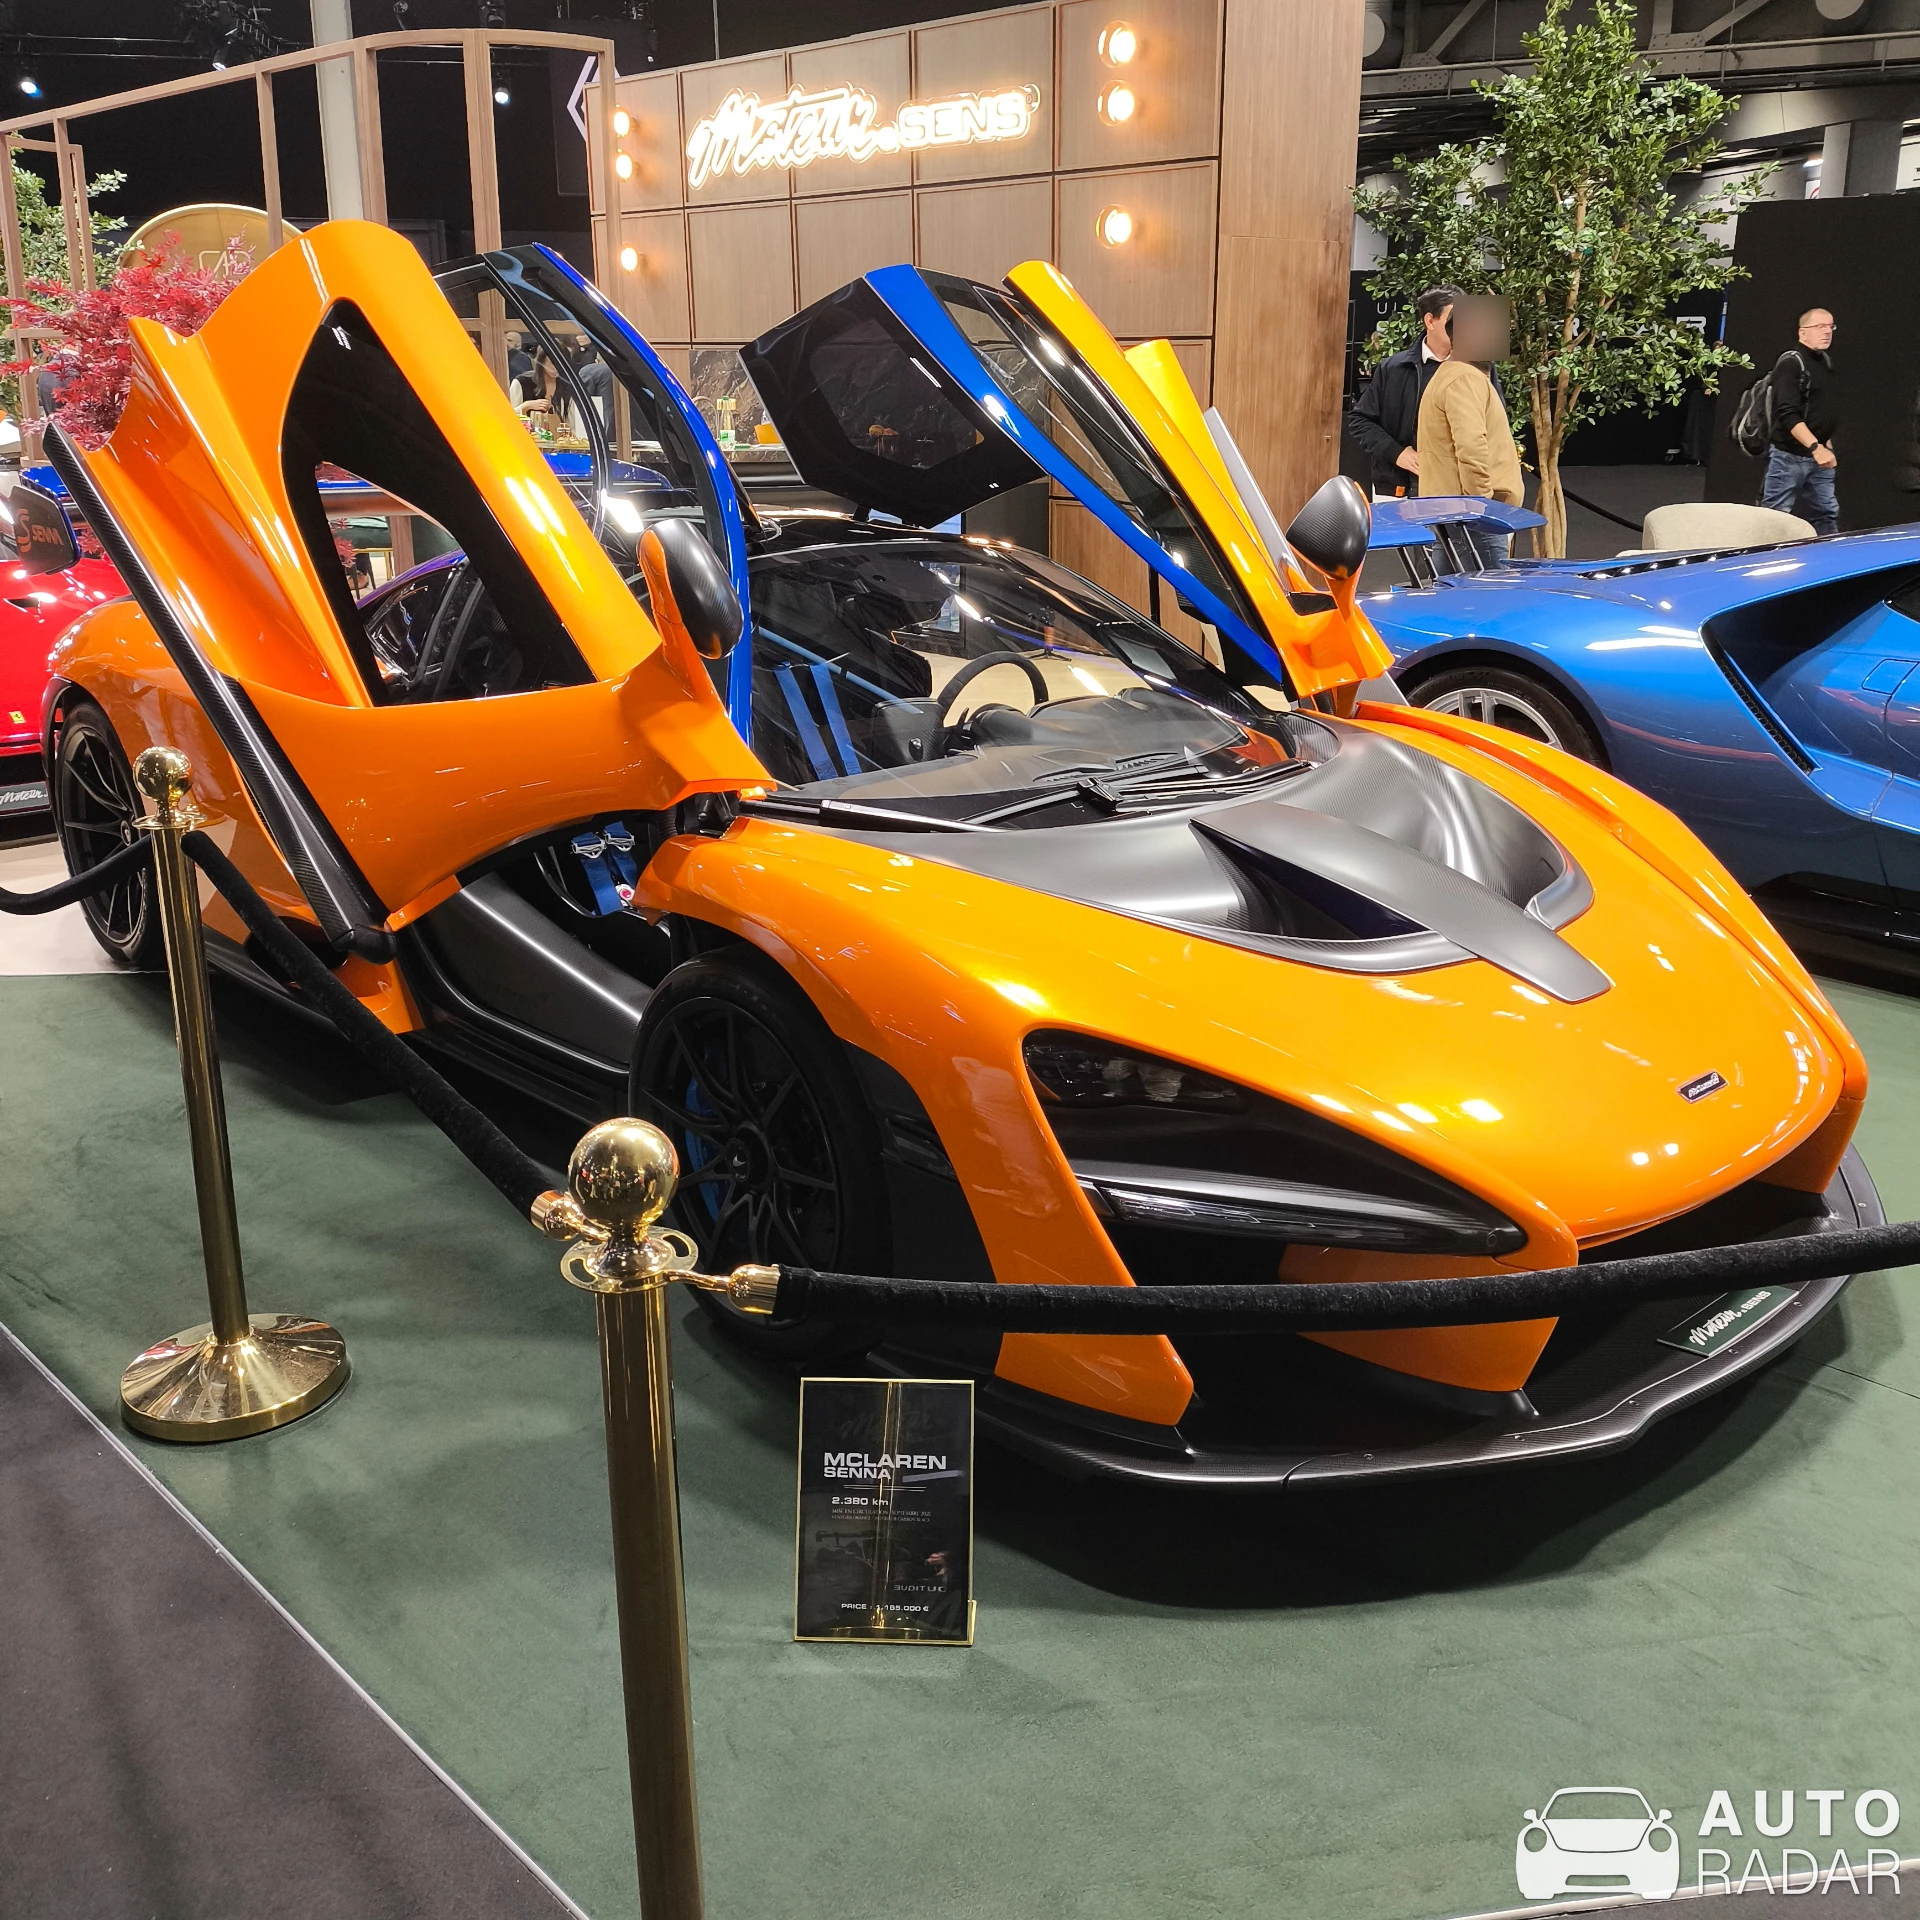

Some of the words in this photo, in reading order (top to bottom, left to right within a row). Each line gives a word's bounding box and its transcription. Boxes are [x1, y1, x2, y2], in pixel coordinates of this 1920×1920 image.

[900, 91, 1028, 149] SENS
[1688, 1309, 1742, 1346] Moteur
[1740, 1290, 1772, 1310] SENS
[823, 1452, 947, 1470] MCLAREN
[823, 1466, 892, 1480] SENNA
[831, 1496, 869, 1506] 2.380
[872, 1498, 889, 1506] km
